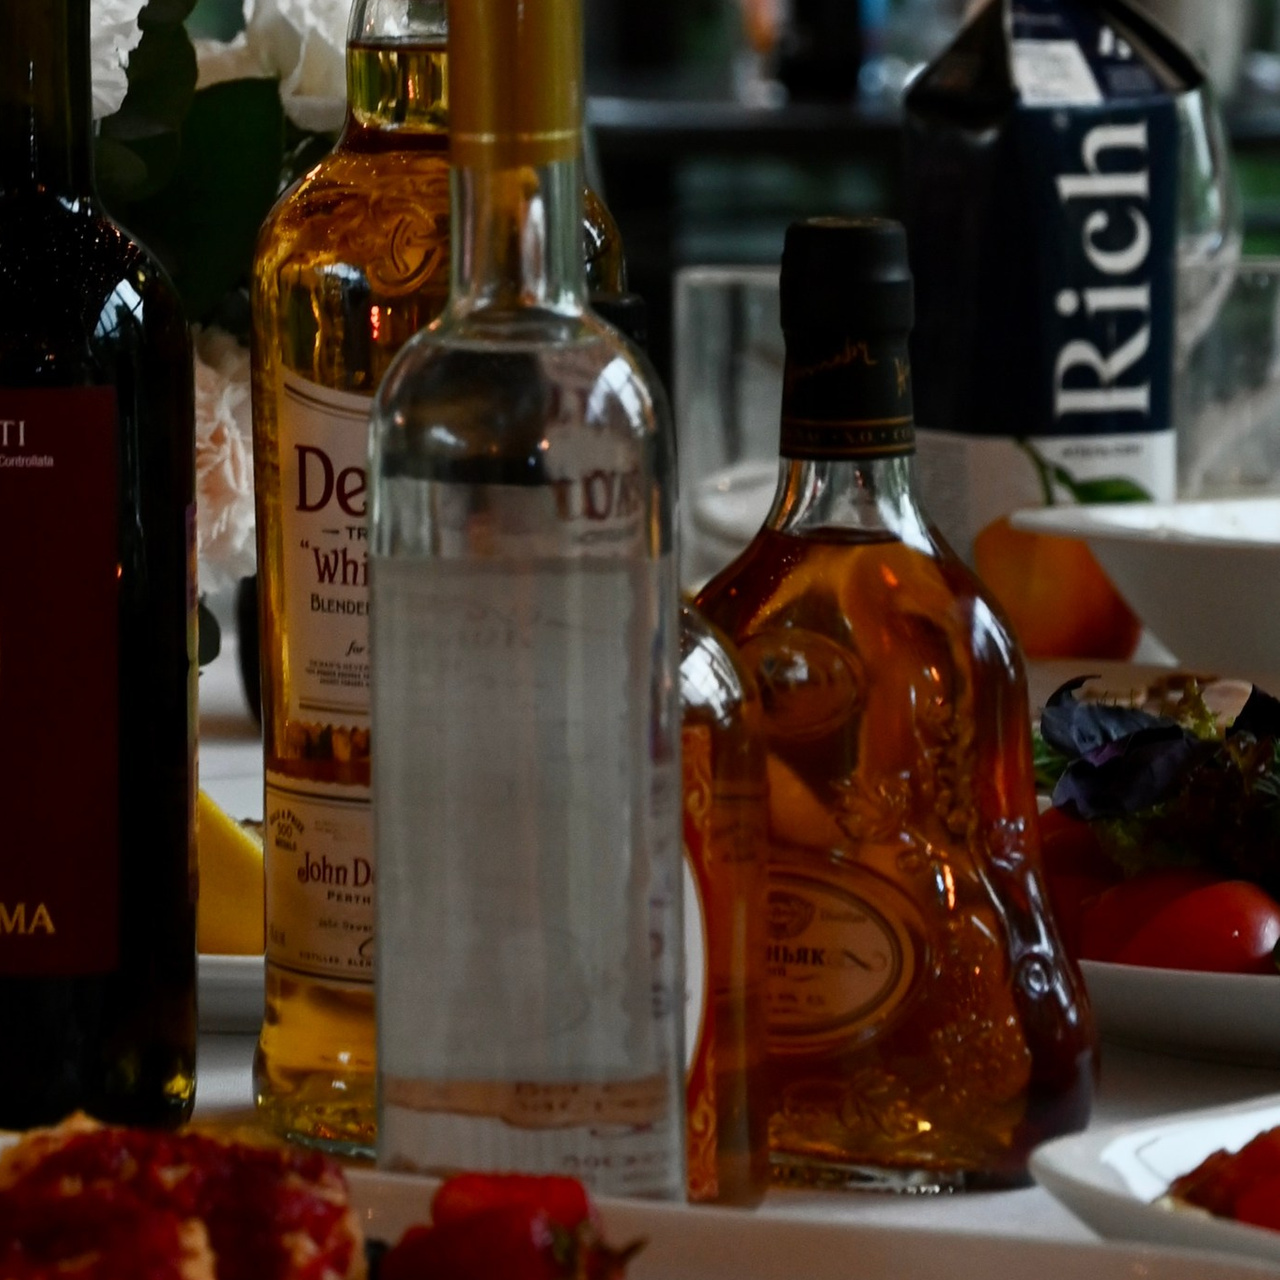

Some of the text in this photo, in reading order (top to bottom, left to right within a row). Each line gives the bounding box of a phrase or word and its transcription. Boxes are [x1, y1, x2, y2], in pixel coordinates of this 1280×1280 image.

[1053, 119, 1152, 420] Rich
[294, 443, 367, 517] De
[346, 527, 368, 540] TR
[300, 539, 368, 586] “Whi
[345, 640, 365, 657] for
[298, 852, 347, 885] John
[766, 945, 825, 965] НЬЯК
